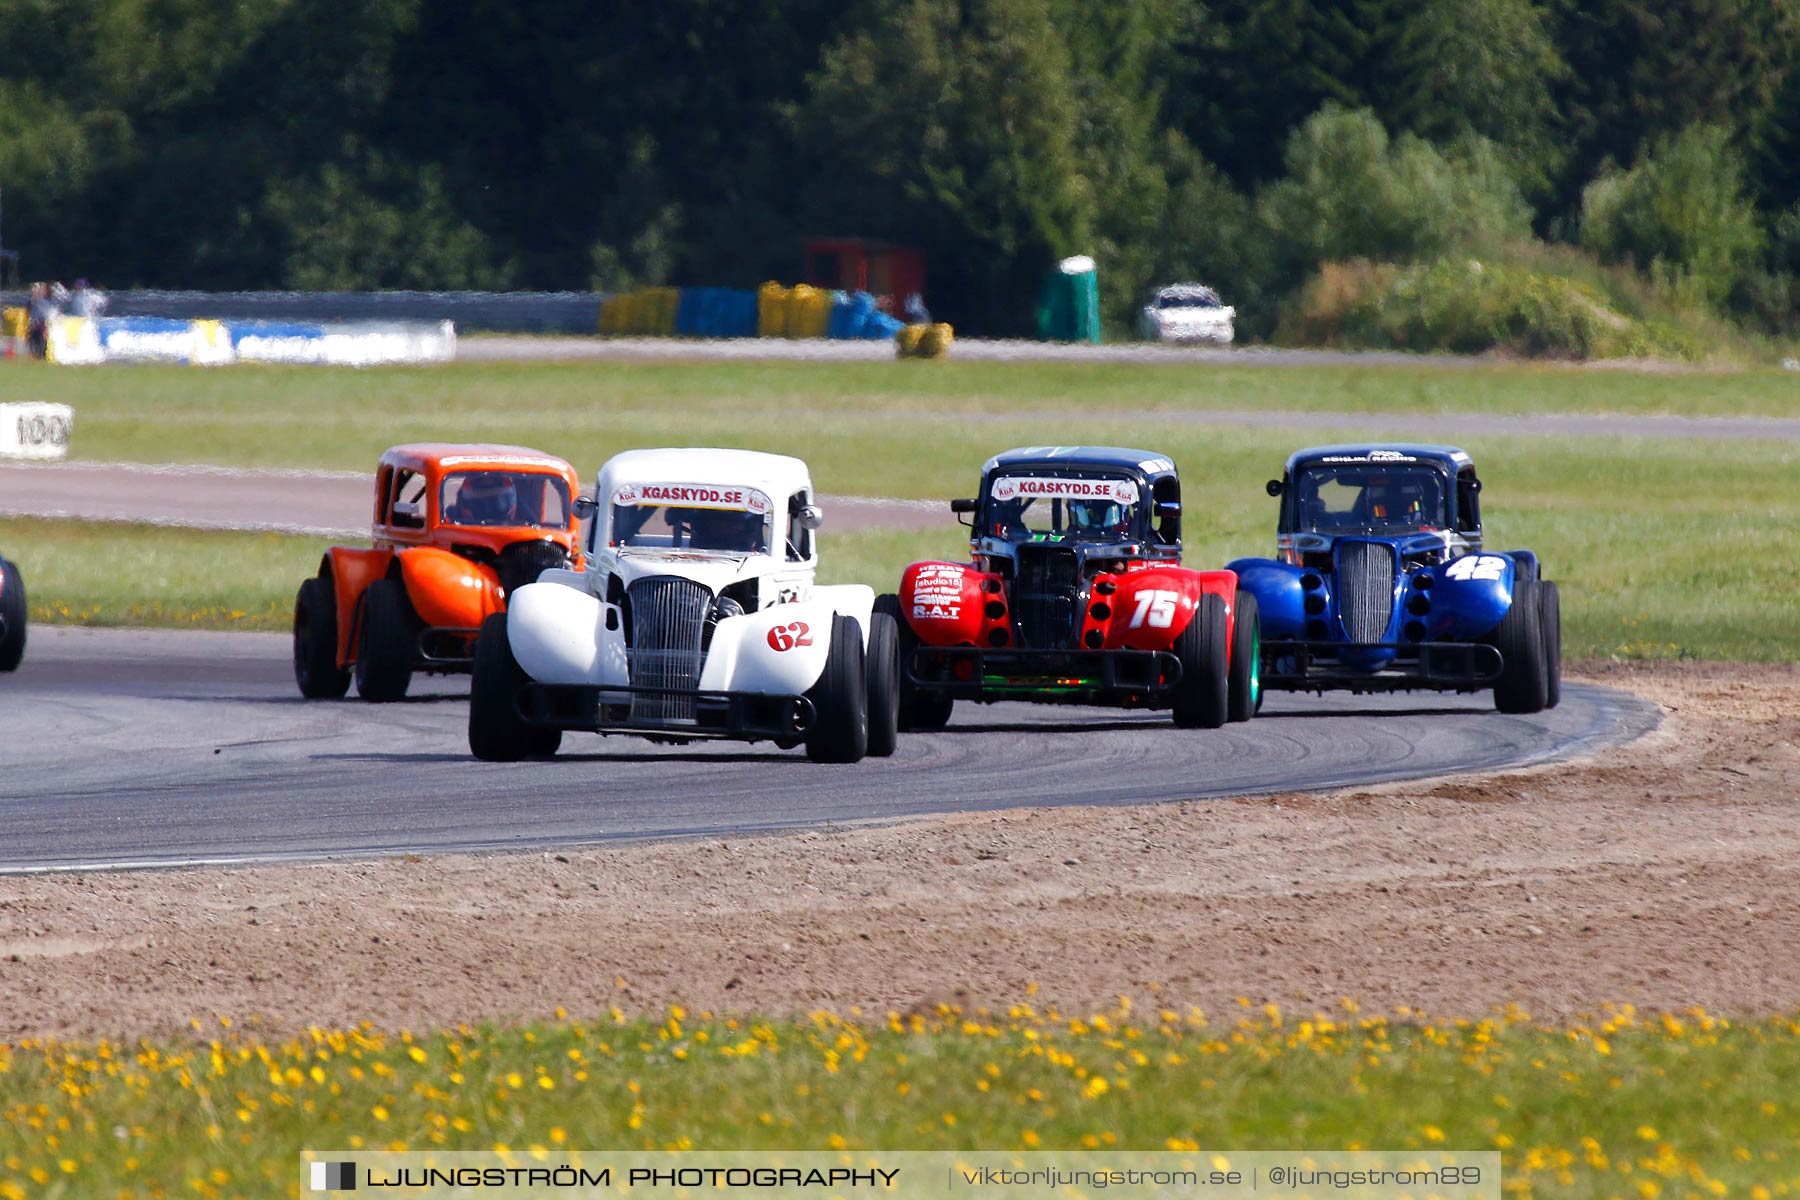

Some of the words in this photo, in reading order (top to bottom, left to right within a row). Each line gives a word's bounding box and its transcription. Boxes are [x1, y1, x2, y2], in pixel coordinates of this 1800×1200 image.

[16, 414, 67, 446] 100
[641, 486, 743, 503] KGASKYDD.SE
[1019, 481, 1111, 495] KGASKYDD.SE
[1445, 555, 1507, 581] 42
[913, 605, 961, 616] R.A.T
[1128, 589, 1179, 629] 75
[766, 621, 814, 652] 62
